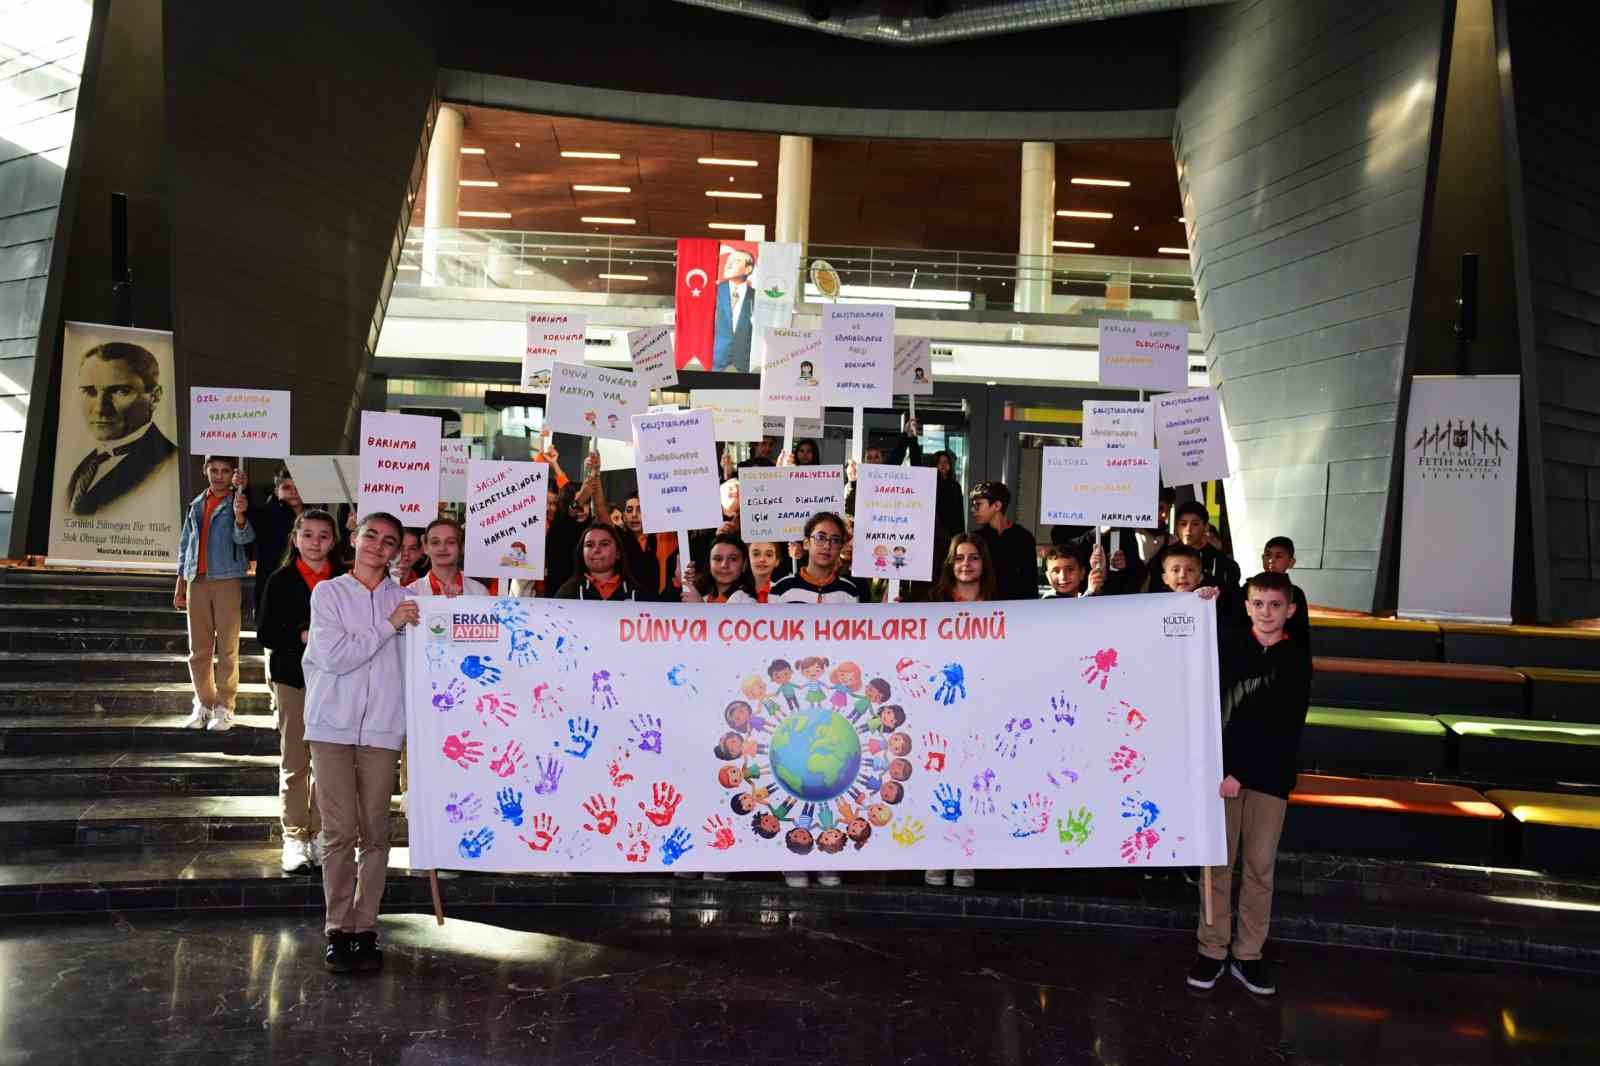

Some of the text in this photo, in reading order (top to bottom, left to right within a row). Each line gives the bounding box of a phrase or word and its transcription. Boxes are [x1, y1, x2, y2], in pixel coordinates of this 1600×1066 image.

[530, 315, 568, 323] BARINMA
[543, 333, 584, 341] KORUNMA
[527, 347, 558, 355] HAKKIM
[559, 386, 622, 400] HAKKIM VAR
[367, 437, 417, 450] BARINMA
[377, 459, 431, 471] KORUNMA
[361, 483, 405, 494] HAKKIM
[875, 486, 915, 494] SANATSAL
[400, 504, 421, 512] VAR
[483, 515, 539, 546] HAKKIM VAR
[866, 532, 896, 540] HAKKIM
[452, 613, 499, 624] ERKAN
[619, 611, 1006, 646] DÜNYA ÇOCUK HAKLARI GÜNÜ
